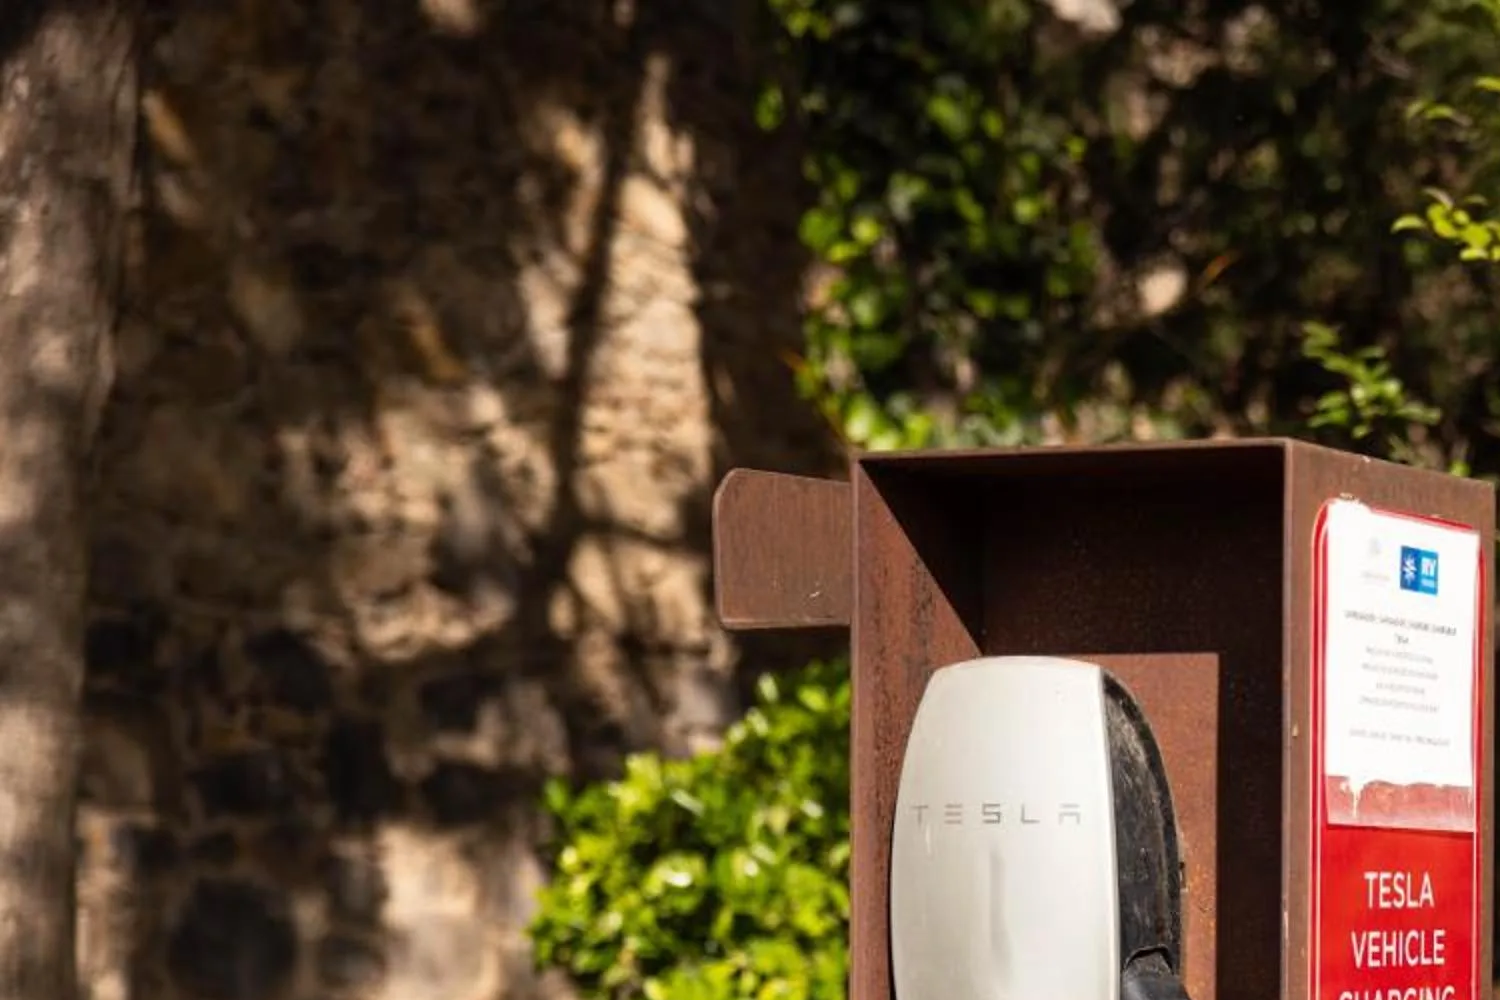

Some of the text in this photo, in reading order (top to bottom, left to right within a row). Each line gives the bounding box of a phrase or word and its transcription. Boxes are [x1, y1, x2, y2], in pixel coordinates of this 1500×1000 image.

[911, 803, 1080, 825] TESLA
[1364, 871, 1434, 908] TESLA
[1351, 929, 1445, 969] VEHICLE
